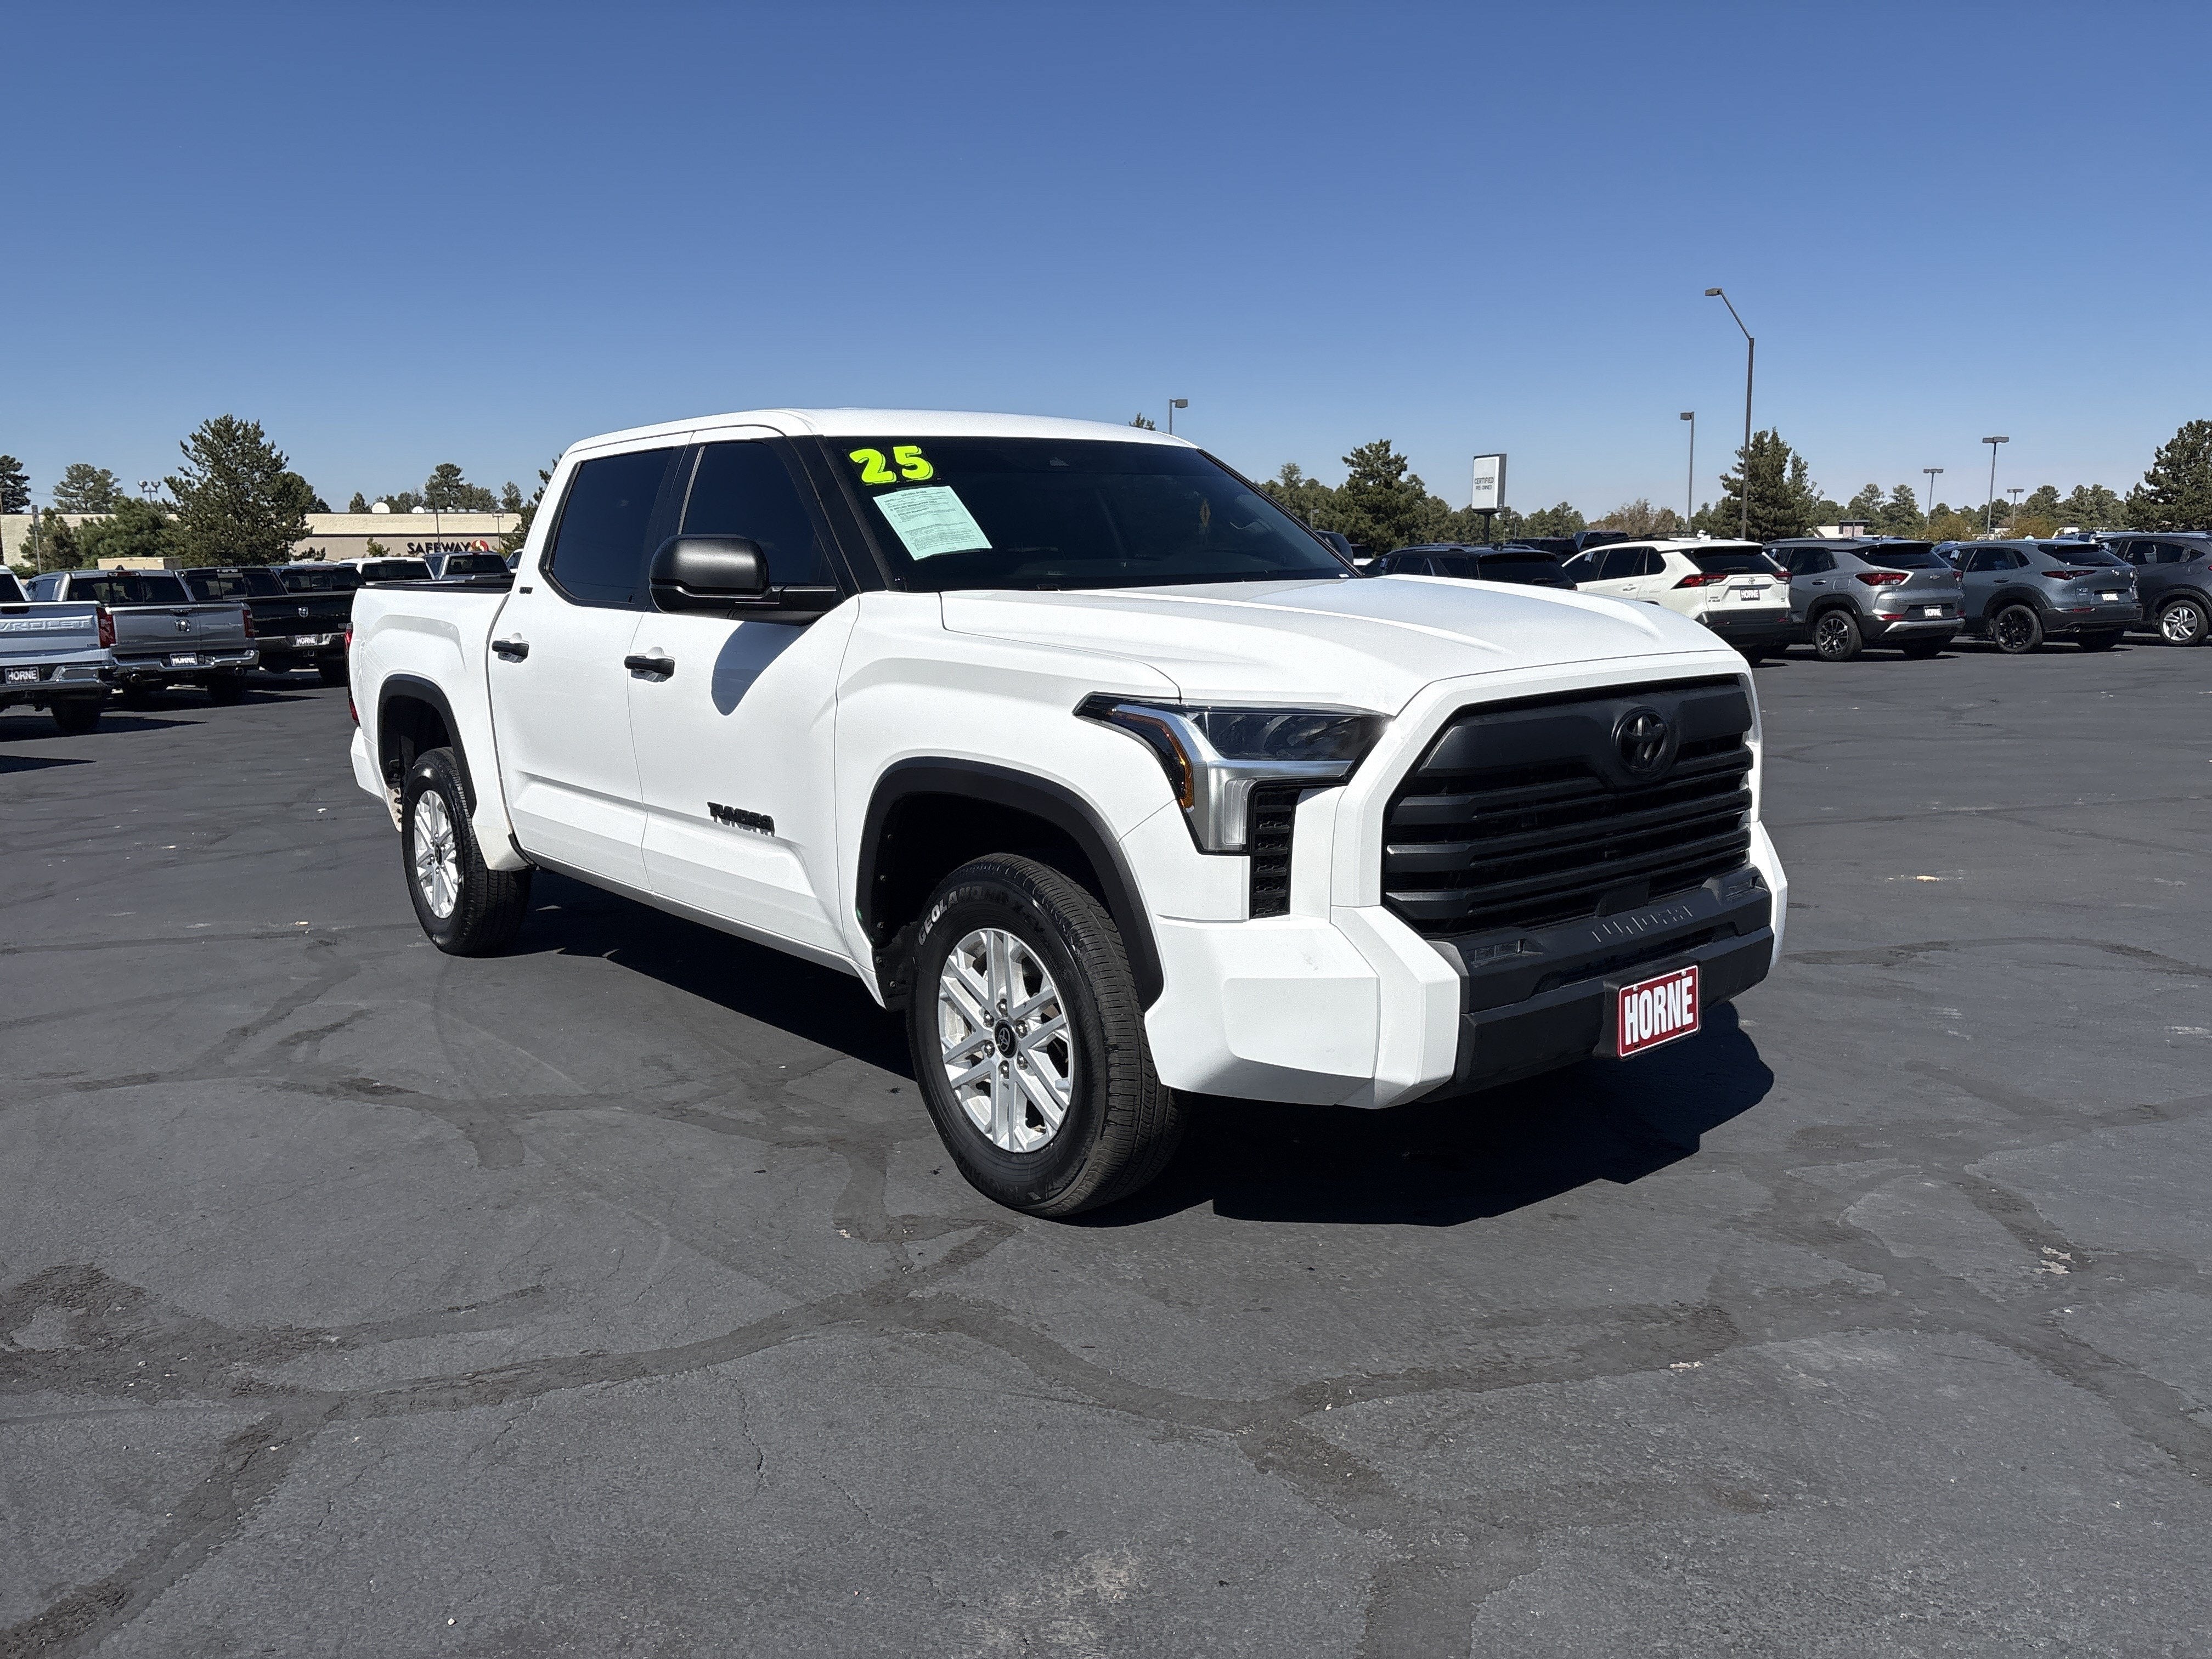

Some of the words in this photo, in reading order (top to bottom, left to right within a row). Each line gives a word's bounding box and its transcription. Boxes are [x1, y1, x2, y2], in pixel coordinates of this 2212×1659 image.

[849, 445, 934, 484] 25
[407, 541, 471, 555] SAFEWAY
[1741, 589, 1759, 599] HORNE
[1925, 608, 1942, 617] HORNE
[296, 636, 316, 645] HORNE
[7, 670, 37, 681] HORNE
[707, 802, 775, 834] TUNDRA
[1624, 975, 1694, 1046] HORNE
